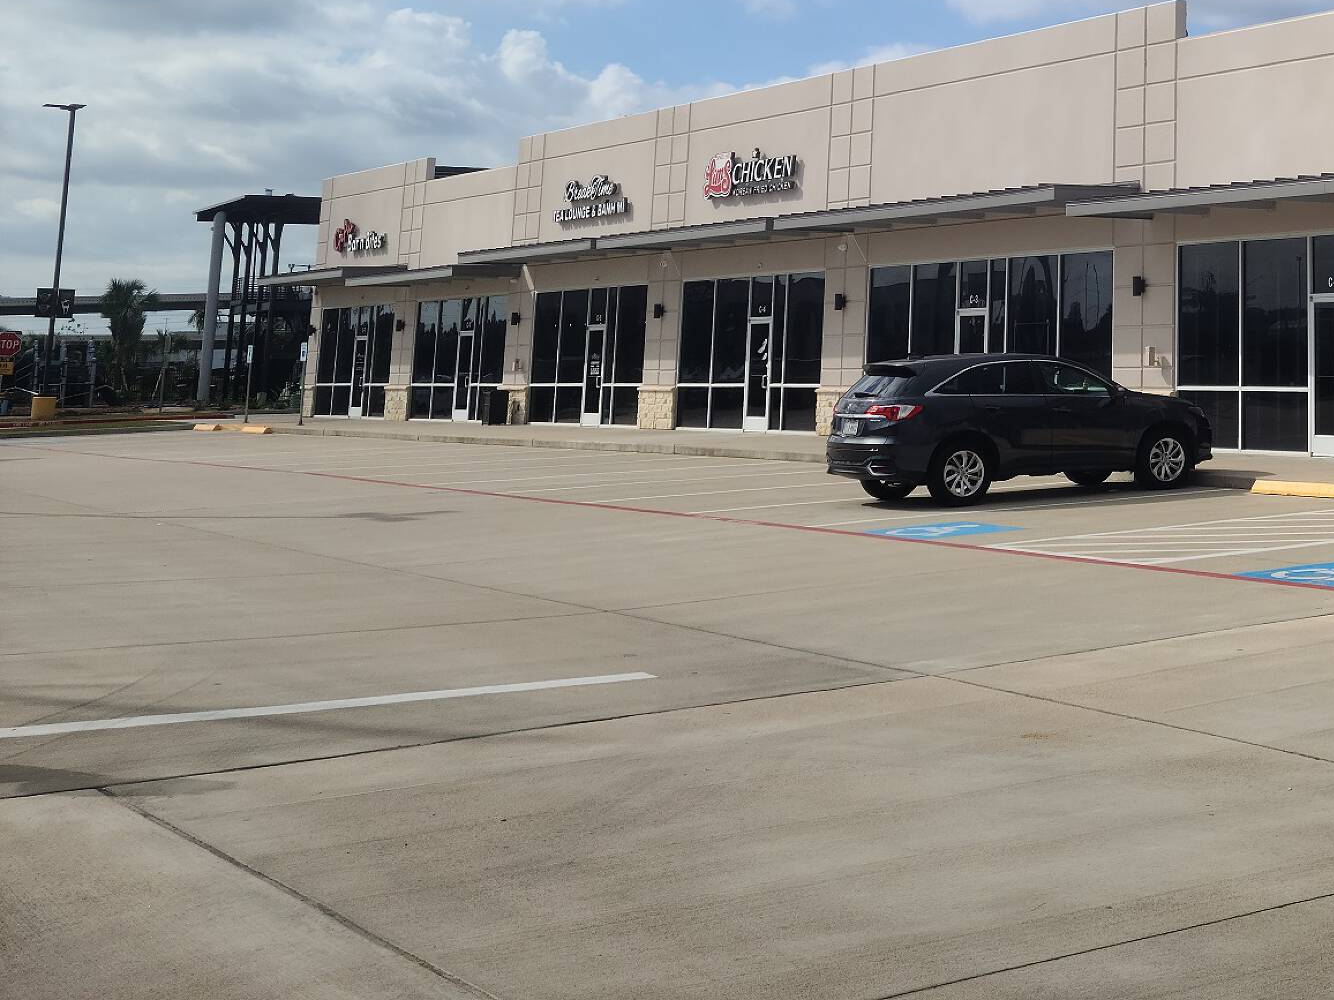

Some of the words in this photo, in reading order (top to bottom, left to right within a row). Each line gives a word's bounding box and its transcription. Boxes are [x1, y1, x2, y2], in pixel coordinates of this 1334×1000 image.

[732, 157, 793, 186] CHICKEN
[554, 209, 564, 222] TEA
[565, 205, 591, 221] LOUNGE
[0, 339, 20, 350] TOP
